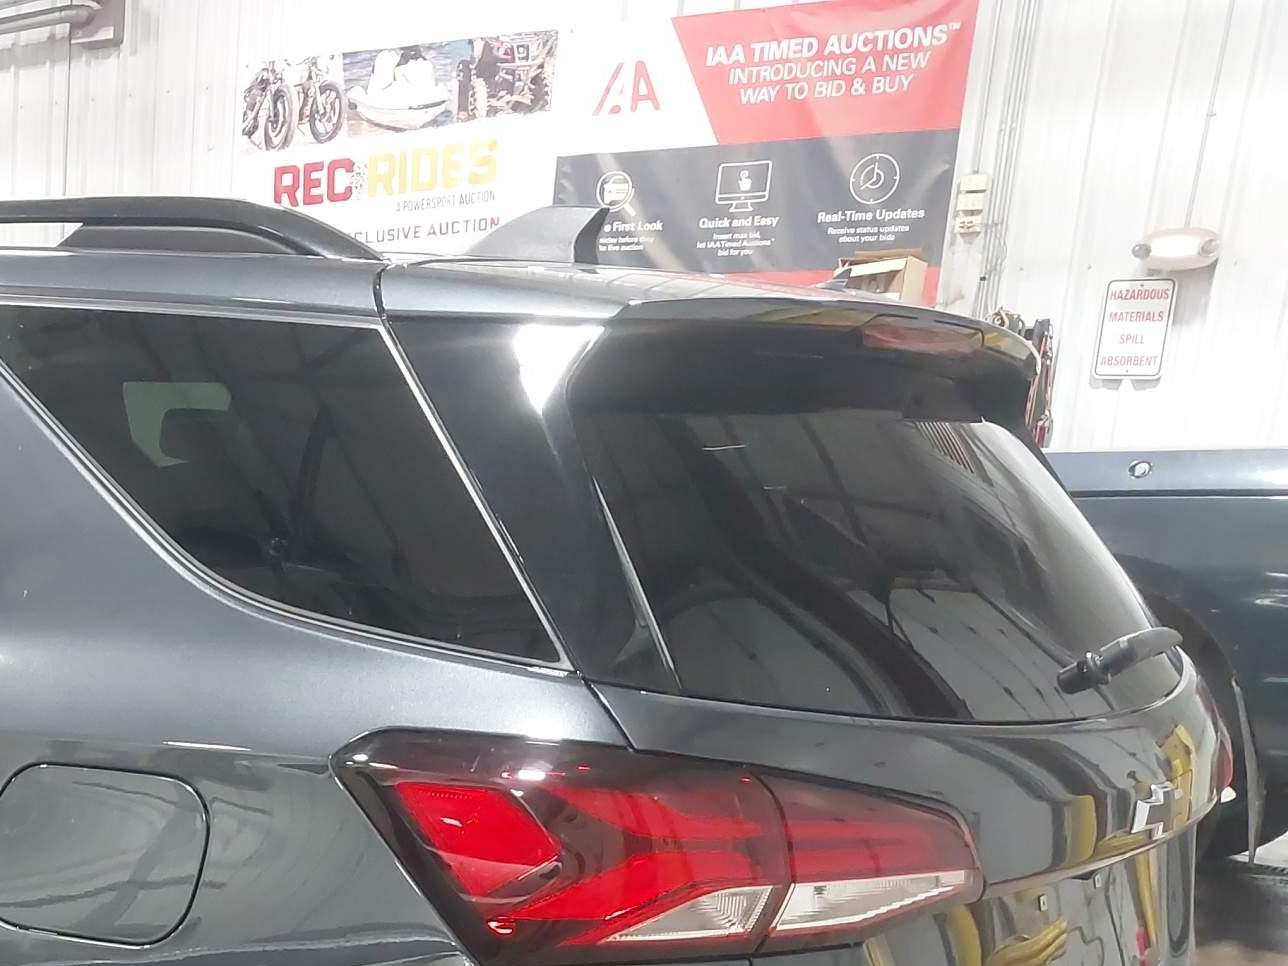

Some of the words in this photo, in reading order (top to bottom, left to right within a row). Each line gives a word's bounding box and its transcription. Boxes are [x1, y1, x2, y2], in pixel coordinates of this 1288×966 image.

[706, 46, 745, 66] IAA
[751, 37, 818, 62] TIMED
[729, 57, 856, 84] INTRODUCING
[862, 56, 876, 73] A
[882, 51, 931, 71] NEW
[739, 84, 780, 104] WAY
[784, 82, 808, 100] TO
[814, 79, 845, 97] BID
[850, 78, 866, 96] &
[872, 74, 914, 94] BUY
[273, 158, 355, 207] REC
[367, 141, 497, 198] RIDES
[459, 189, 496, 206] AUCTION
[699, 217, 730, 229] Quick
[732, 217, 752, 227] and
[754, 216, 779, 228] Easy
[817, 210, 873, 223] Real-Time
[876, 208, 925, 222] Updates
[427, 216, 500, 237] AUCTION
[612, 221, 635, 232] First
[637, 220, 664, 232] Look
[1110, 288, 1170, 300] HAZARDOUS
[1108, 311, 1164, 322] MATERIALS
[1119, 333, 1144, 344] SPILL
[1100, 355, 1158, 366] ABSORBENT
